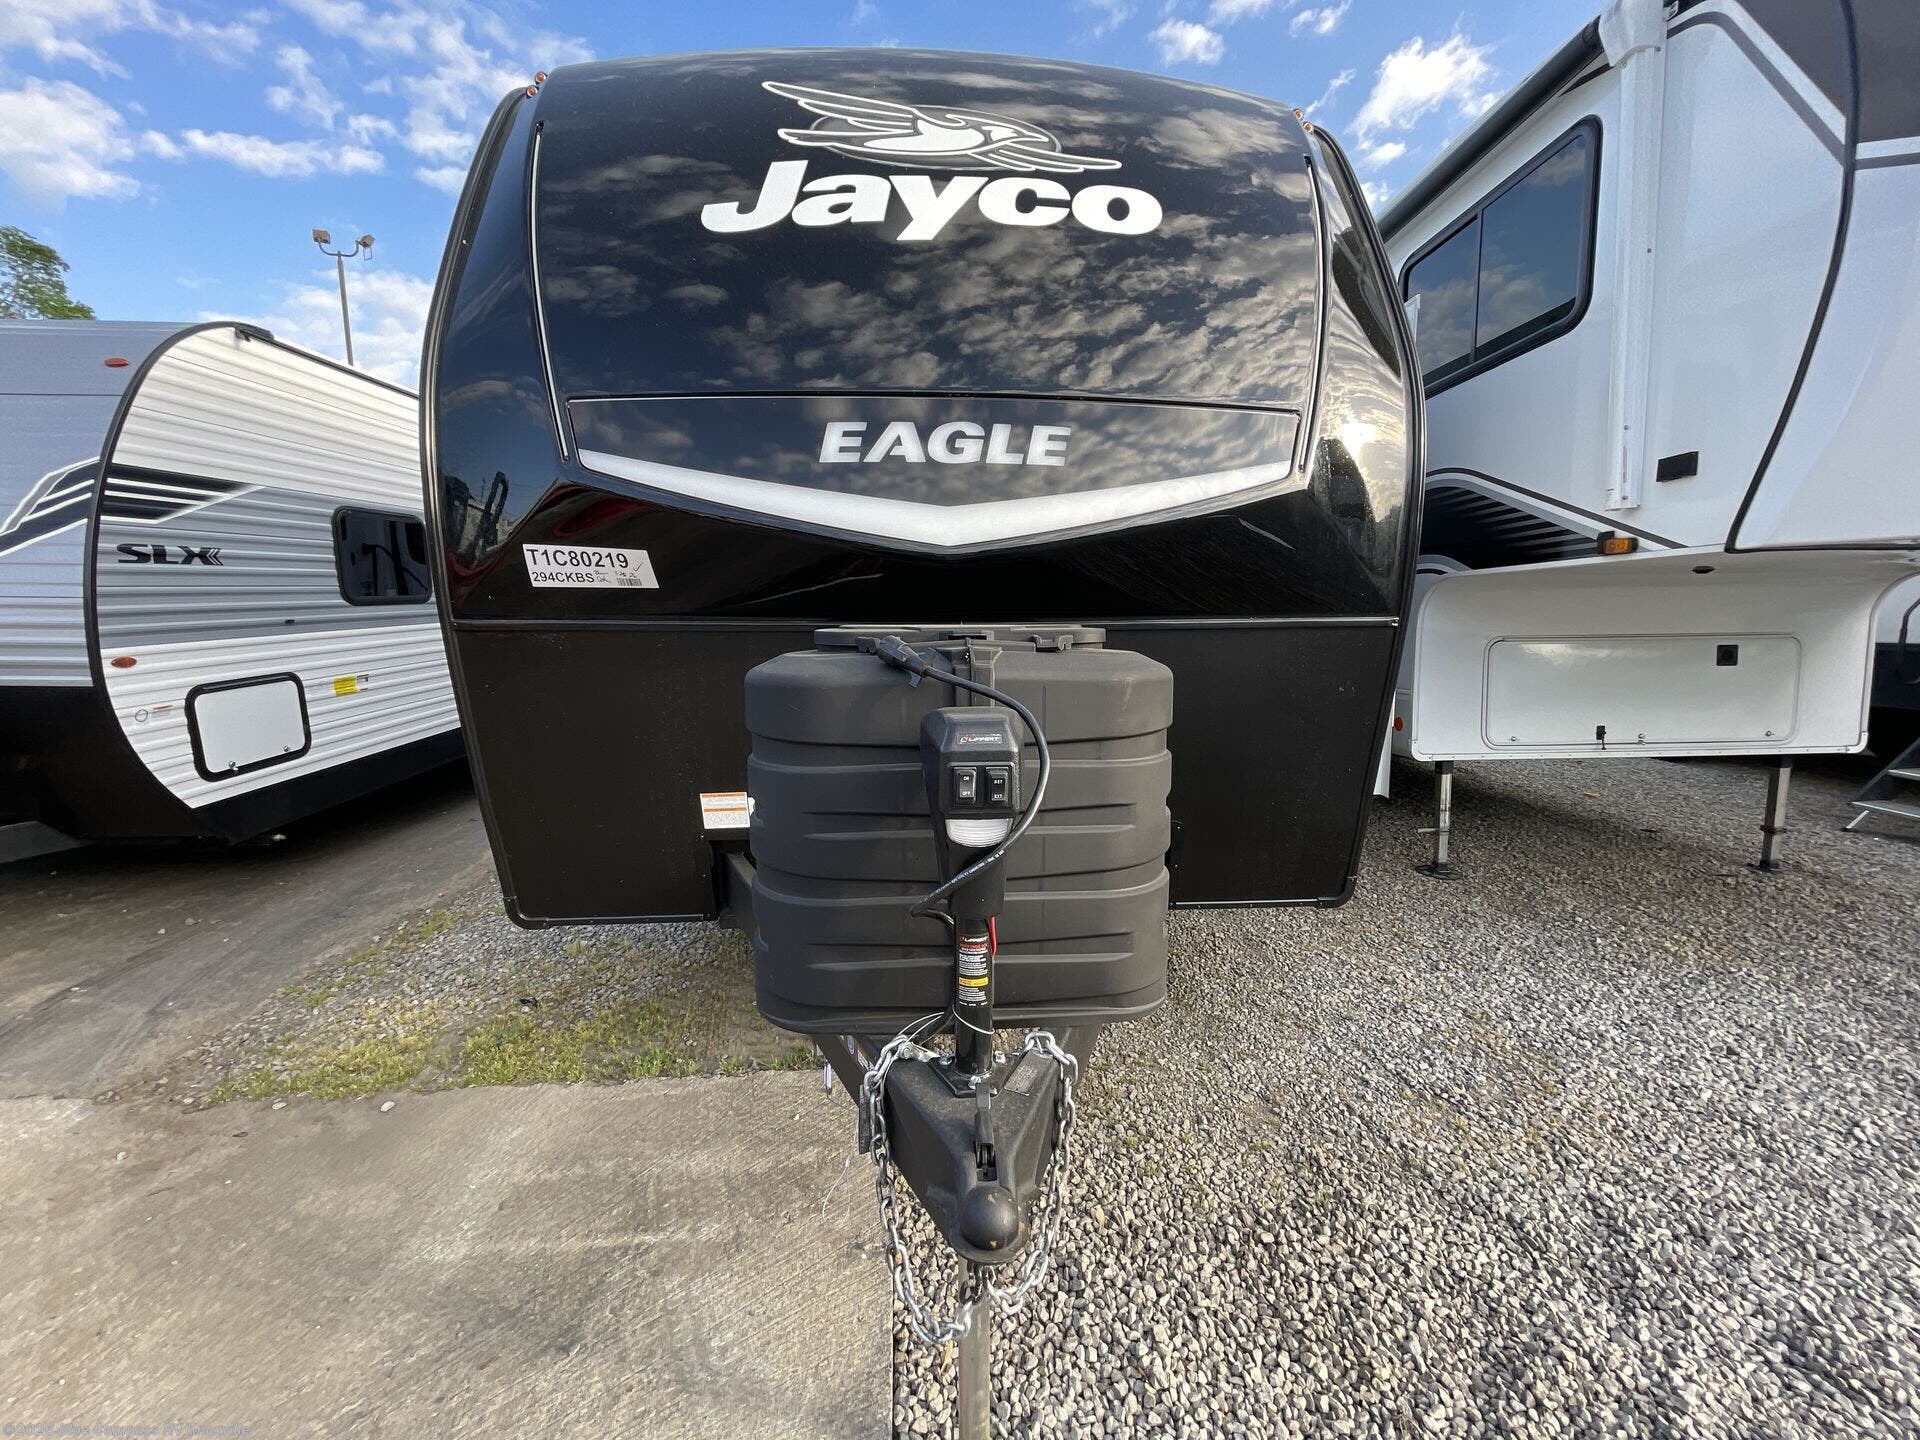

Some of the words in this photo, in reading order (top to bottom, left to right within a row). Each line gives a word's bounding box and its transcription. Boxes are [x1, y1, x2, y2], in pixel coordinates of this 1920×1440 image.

[700, 159, 1163, 241] Jayco
[818, 421, 1072, 467] EAGLE
[526, 548, 629, 569] T1C80219
[531, 571, 595, 583] 294CKBS
